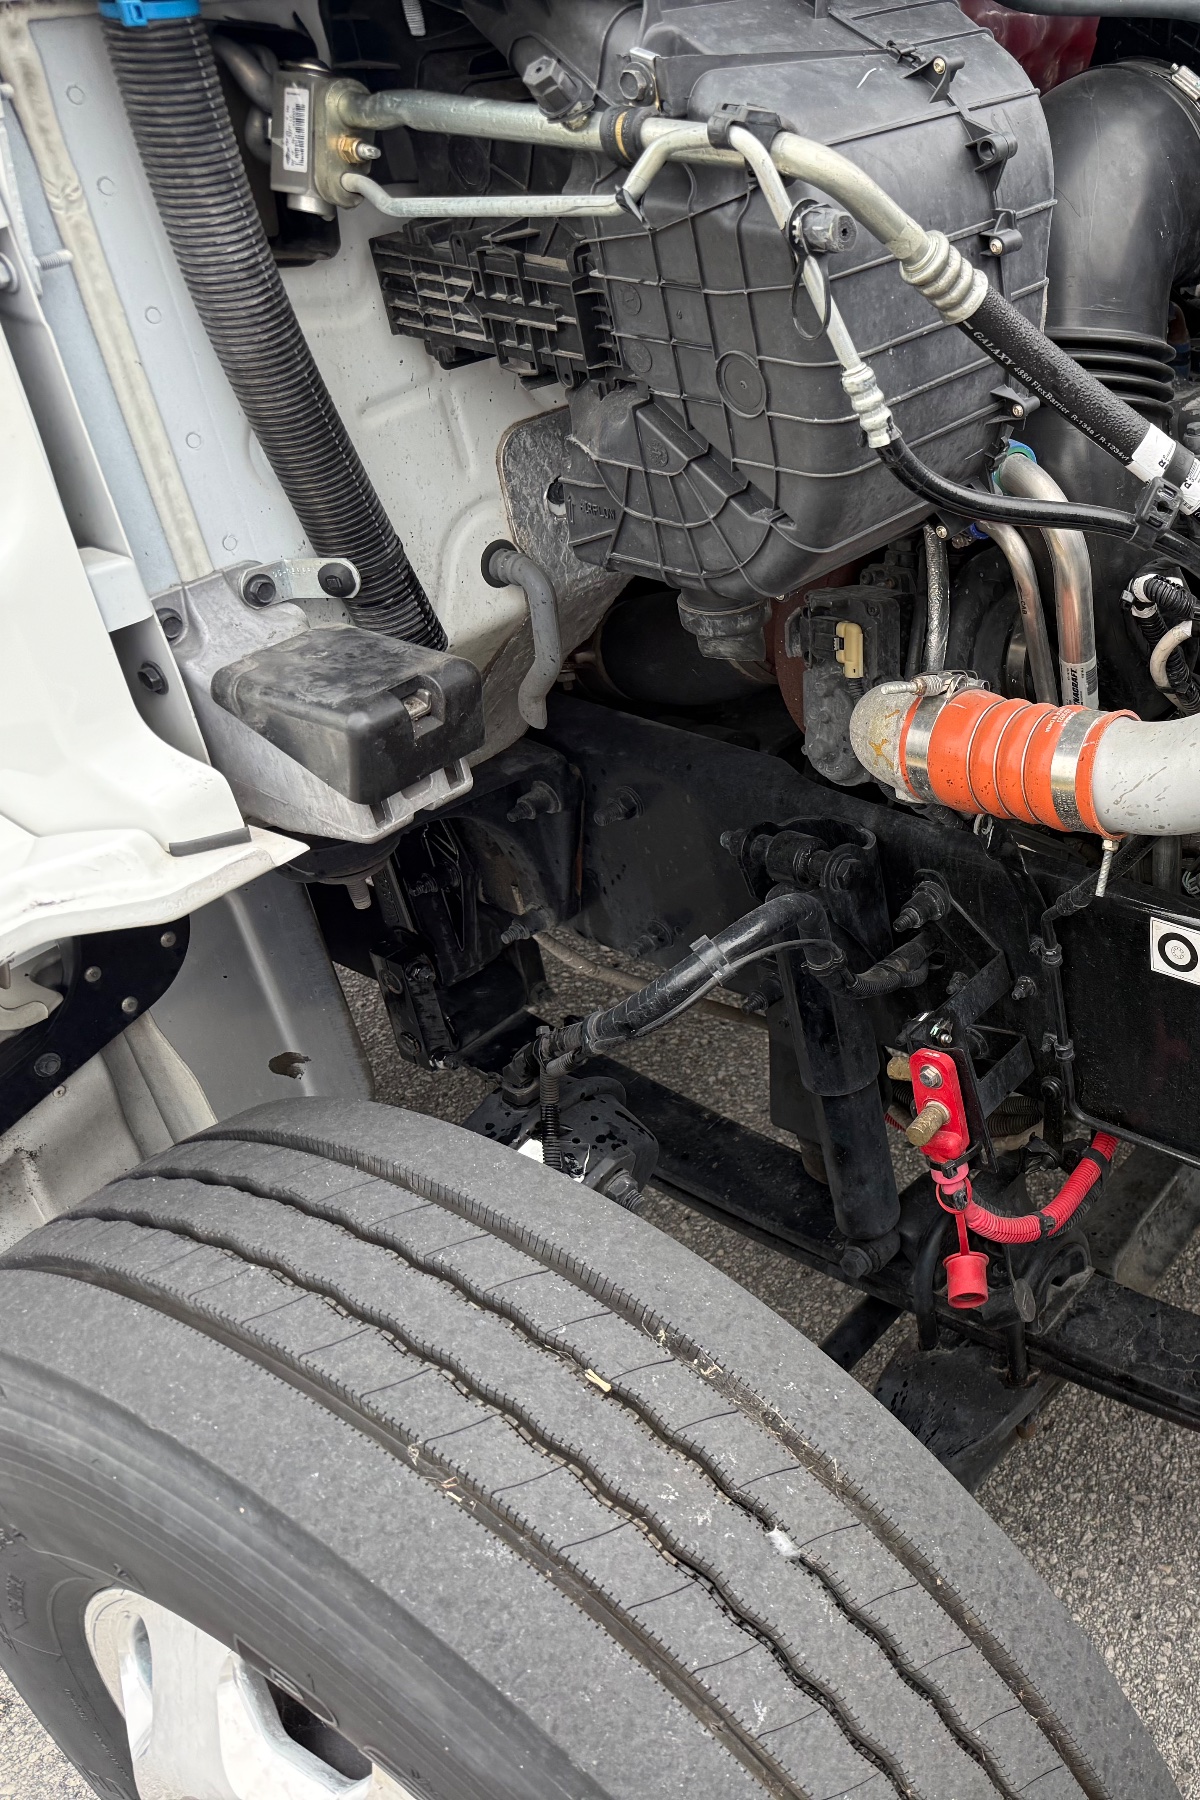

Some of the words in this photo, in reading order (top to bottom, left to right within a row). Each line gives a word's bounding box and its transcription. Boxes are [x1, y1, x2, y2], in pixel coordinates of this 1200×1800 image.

[973, 331, 1015, 366] GALAXY
[1013, 366, 1032, 383] 4880
[1031, 380, 1070, 414] FlexBarrier
[1070, 414, 1095, 434] R-134a
